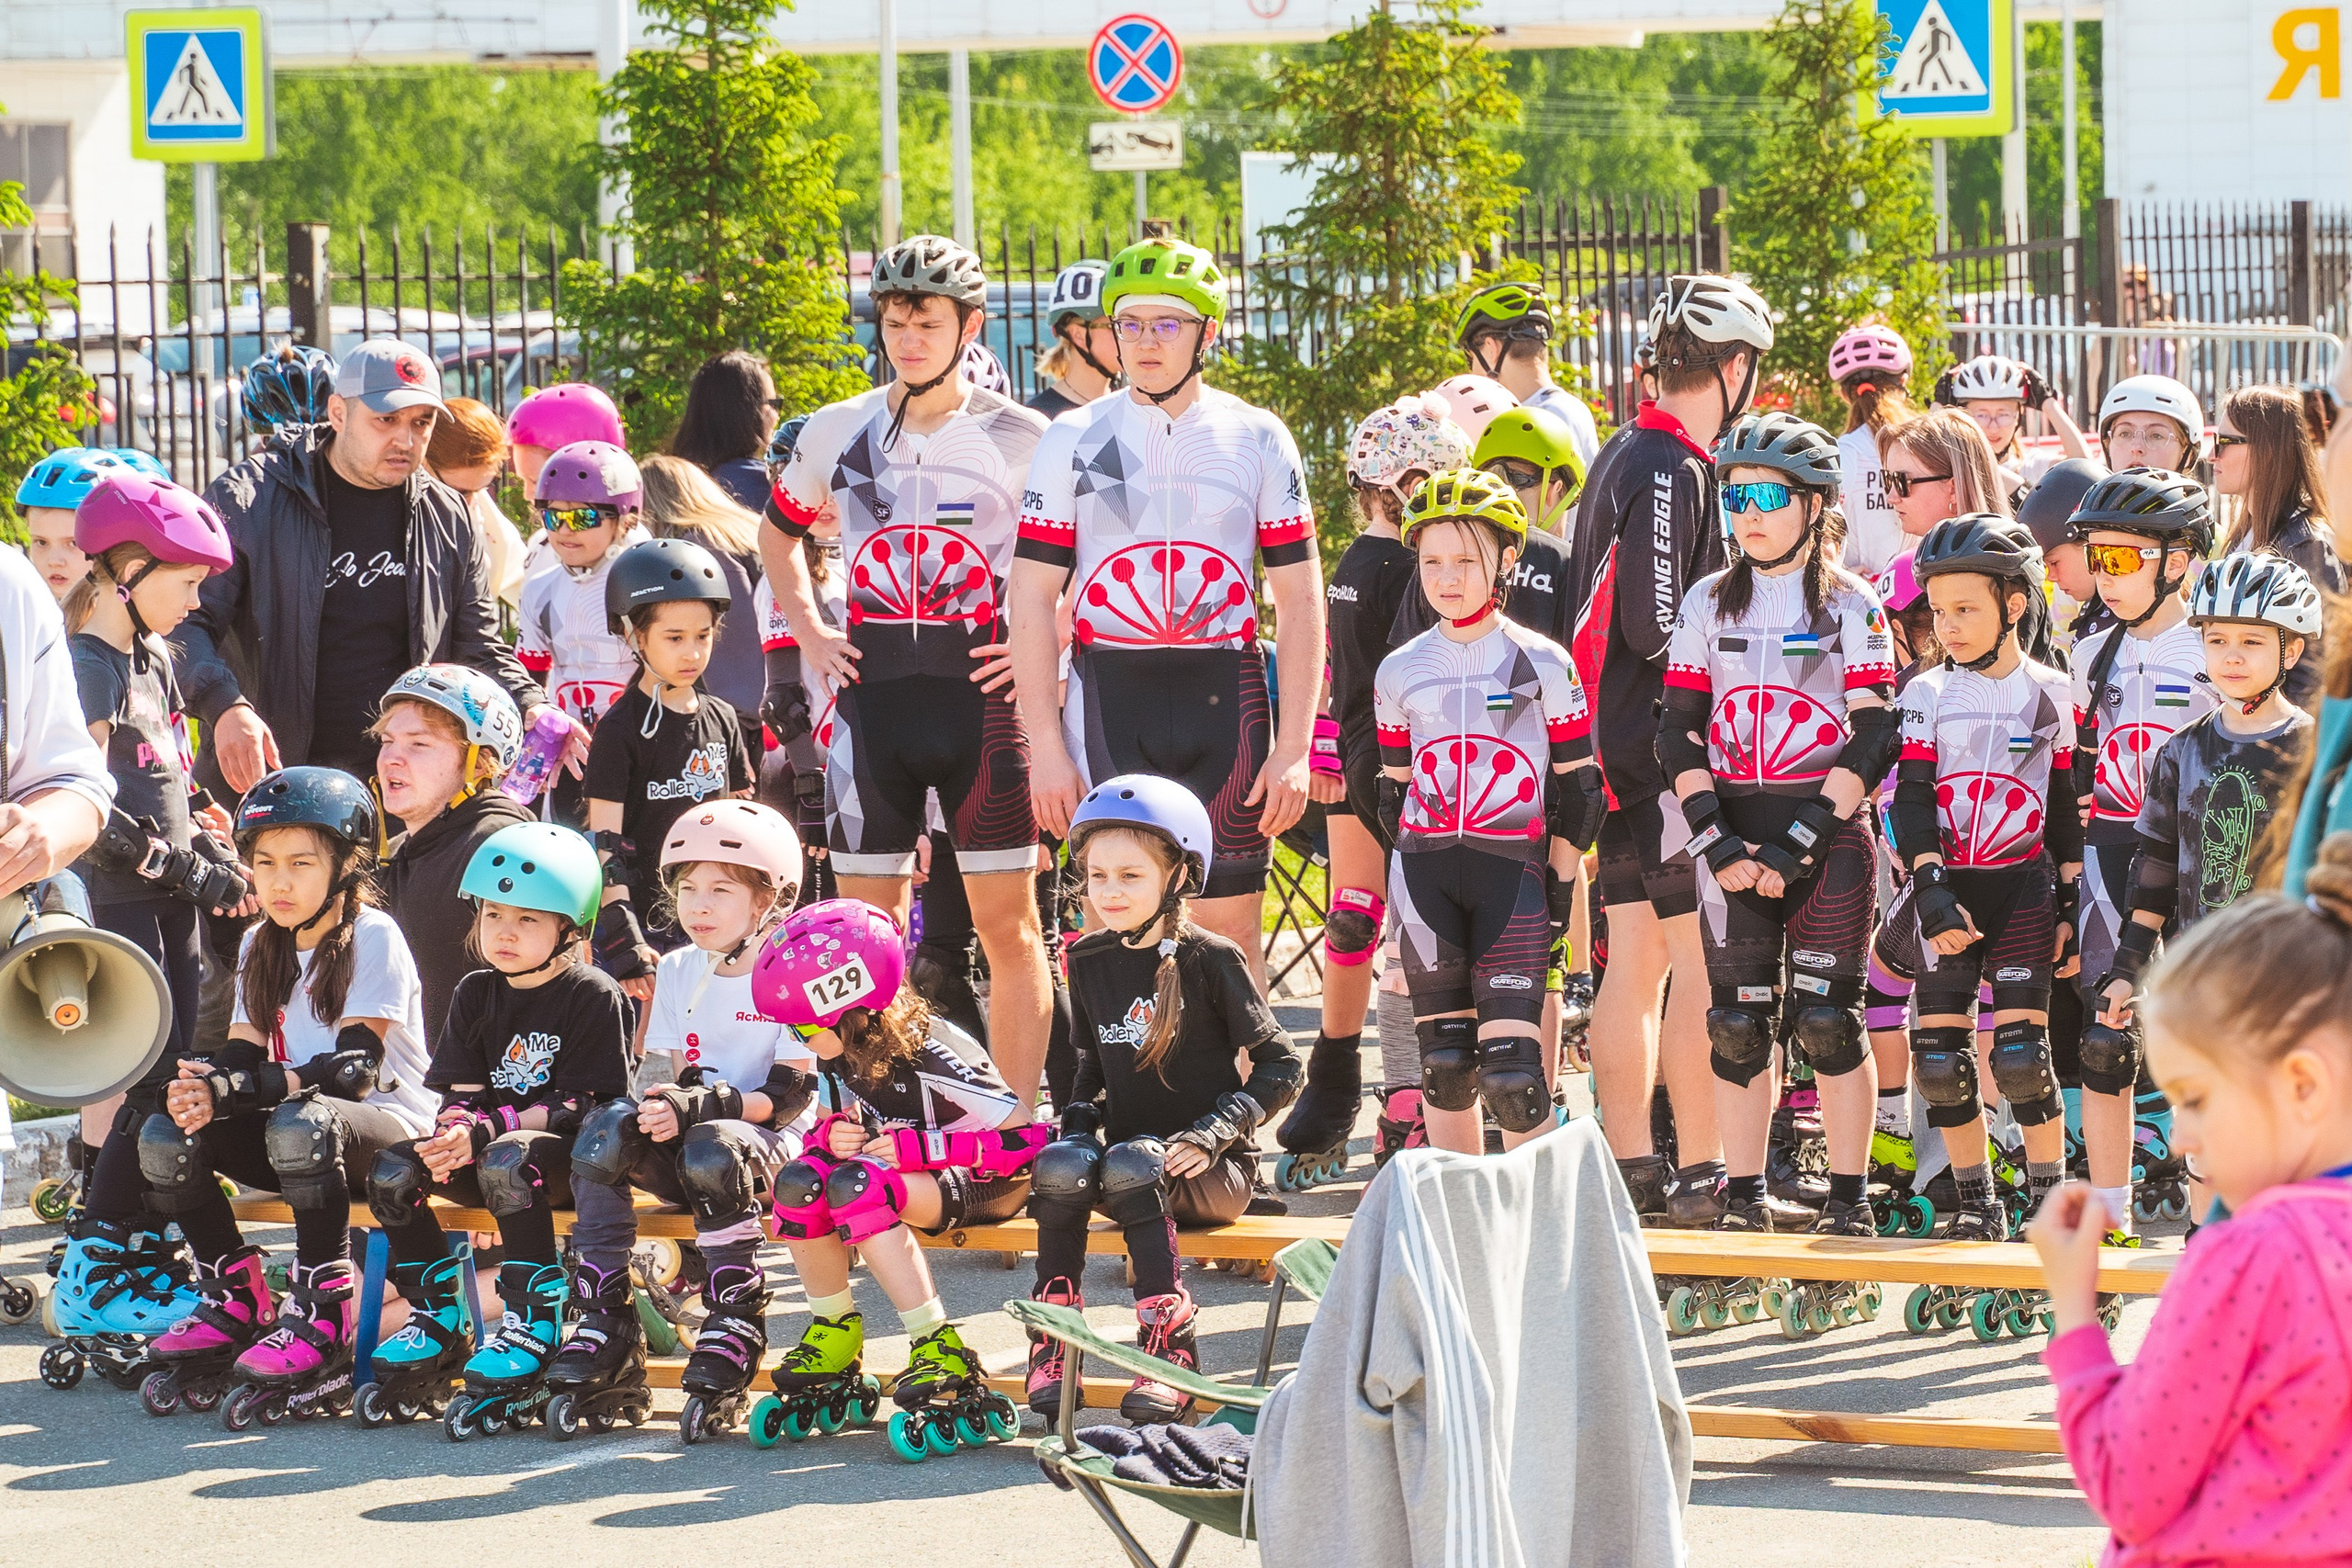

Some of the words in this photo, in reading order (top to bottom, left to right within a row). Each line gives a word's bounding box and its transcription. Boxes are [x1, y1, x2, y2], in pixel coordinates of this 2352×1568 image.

[1053, 272, 1092, 303] 10
[630, 585, 665, 598] REACTION
[492, 710, 514, 739] 55
[649, 782, 695, 797] Roller
[811, 965, 863, 1007] 129
[501, 1329, 548, 1355] Rollerblade
